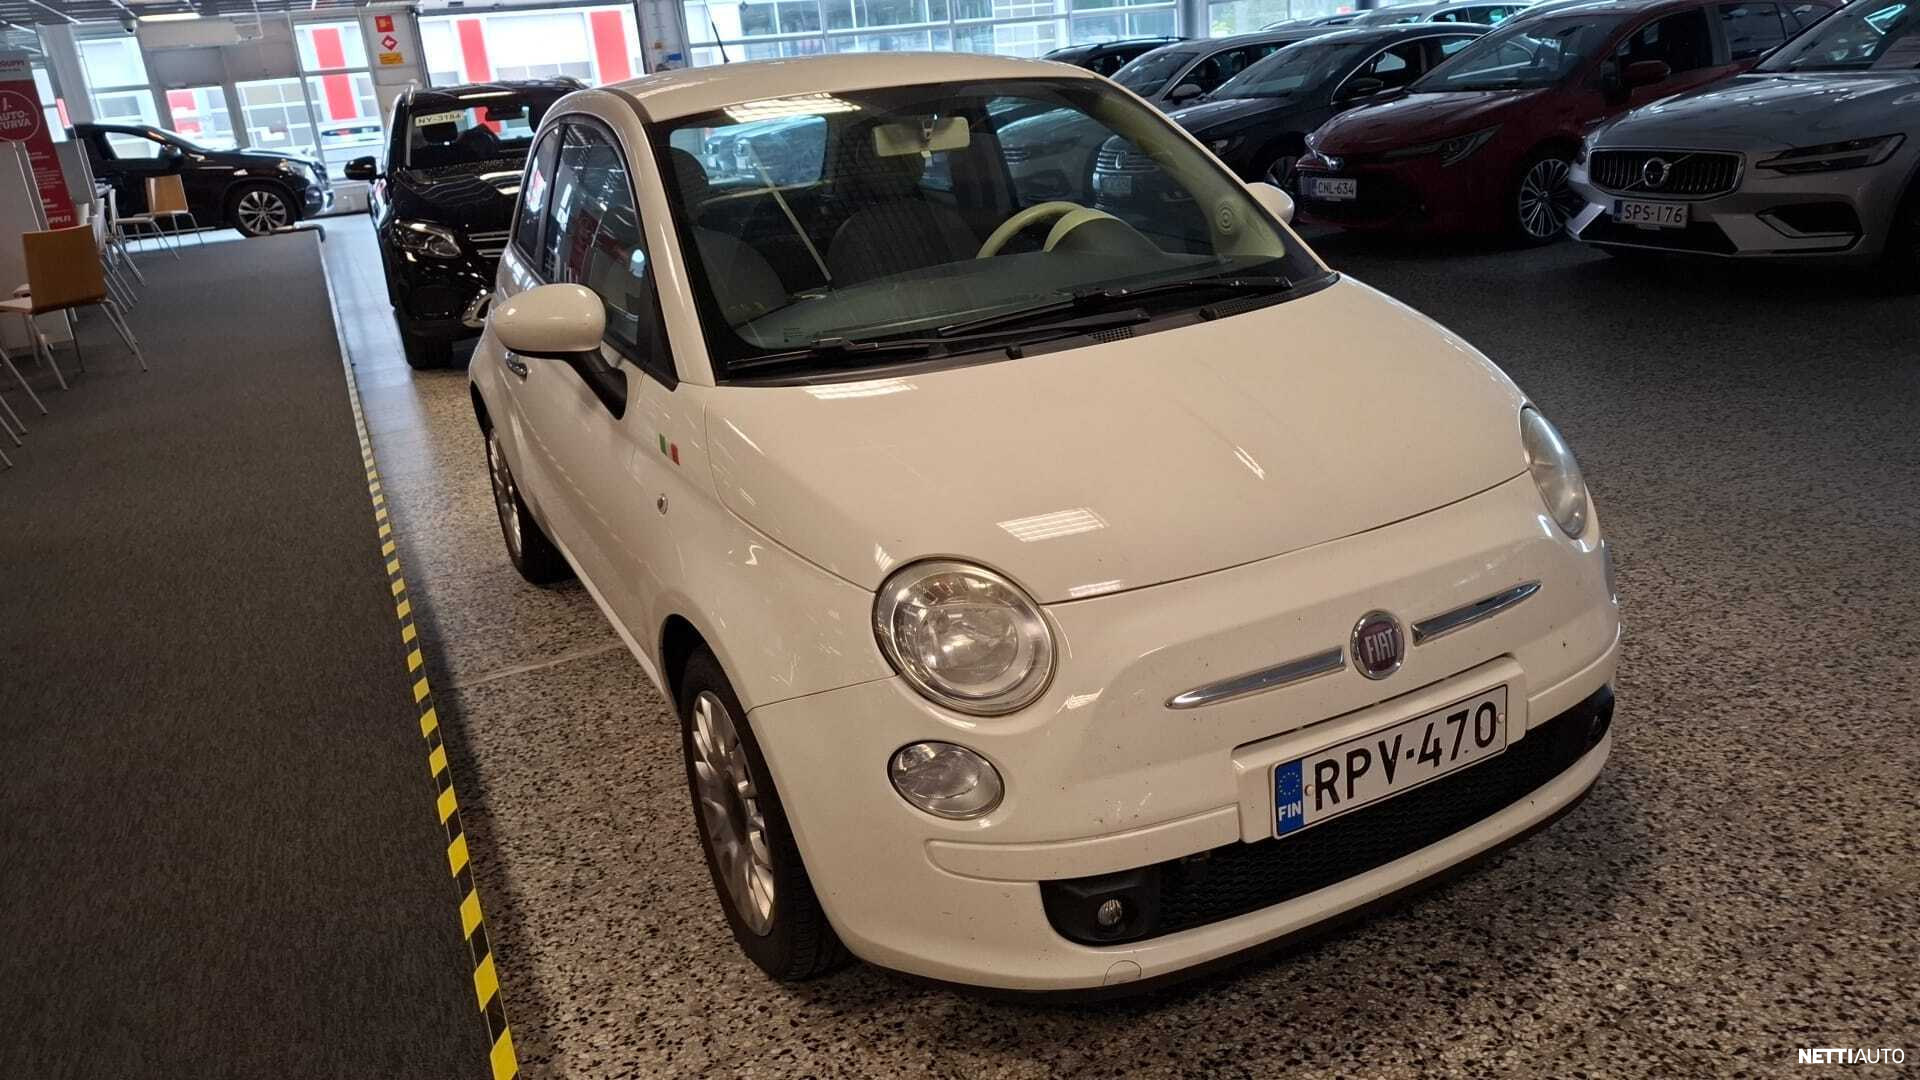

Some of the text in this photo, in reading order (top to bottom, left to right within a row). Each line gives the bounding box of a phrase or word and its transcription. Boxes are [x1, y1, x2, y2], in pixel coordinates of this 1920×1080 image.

[1318, 181, 1354, 196] CNL-634
[1624, 203, 1683, 223] SPS-176
[1364, 628, 1395, 664] FIAT
[1314, 701, 1497, 811] RPV-470
[1277, 800, 1302, 822] FIN
